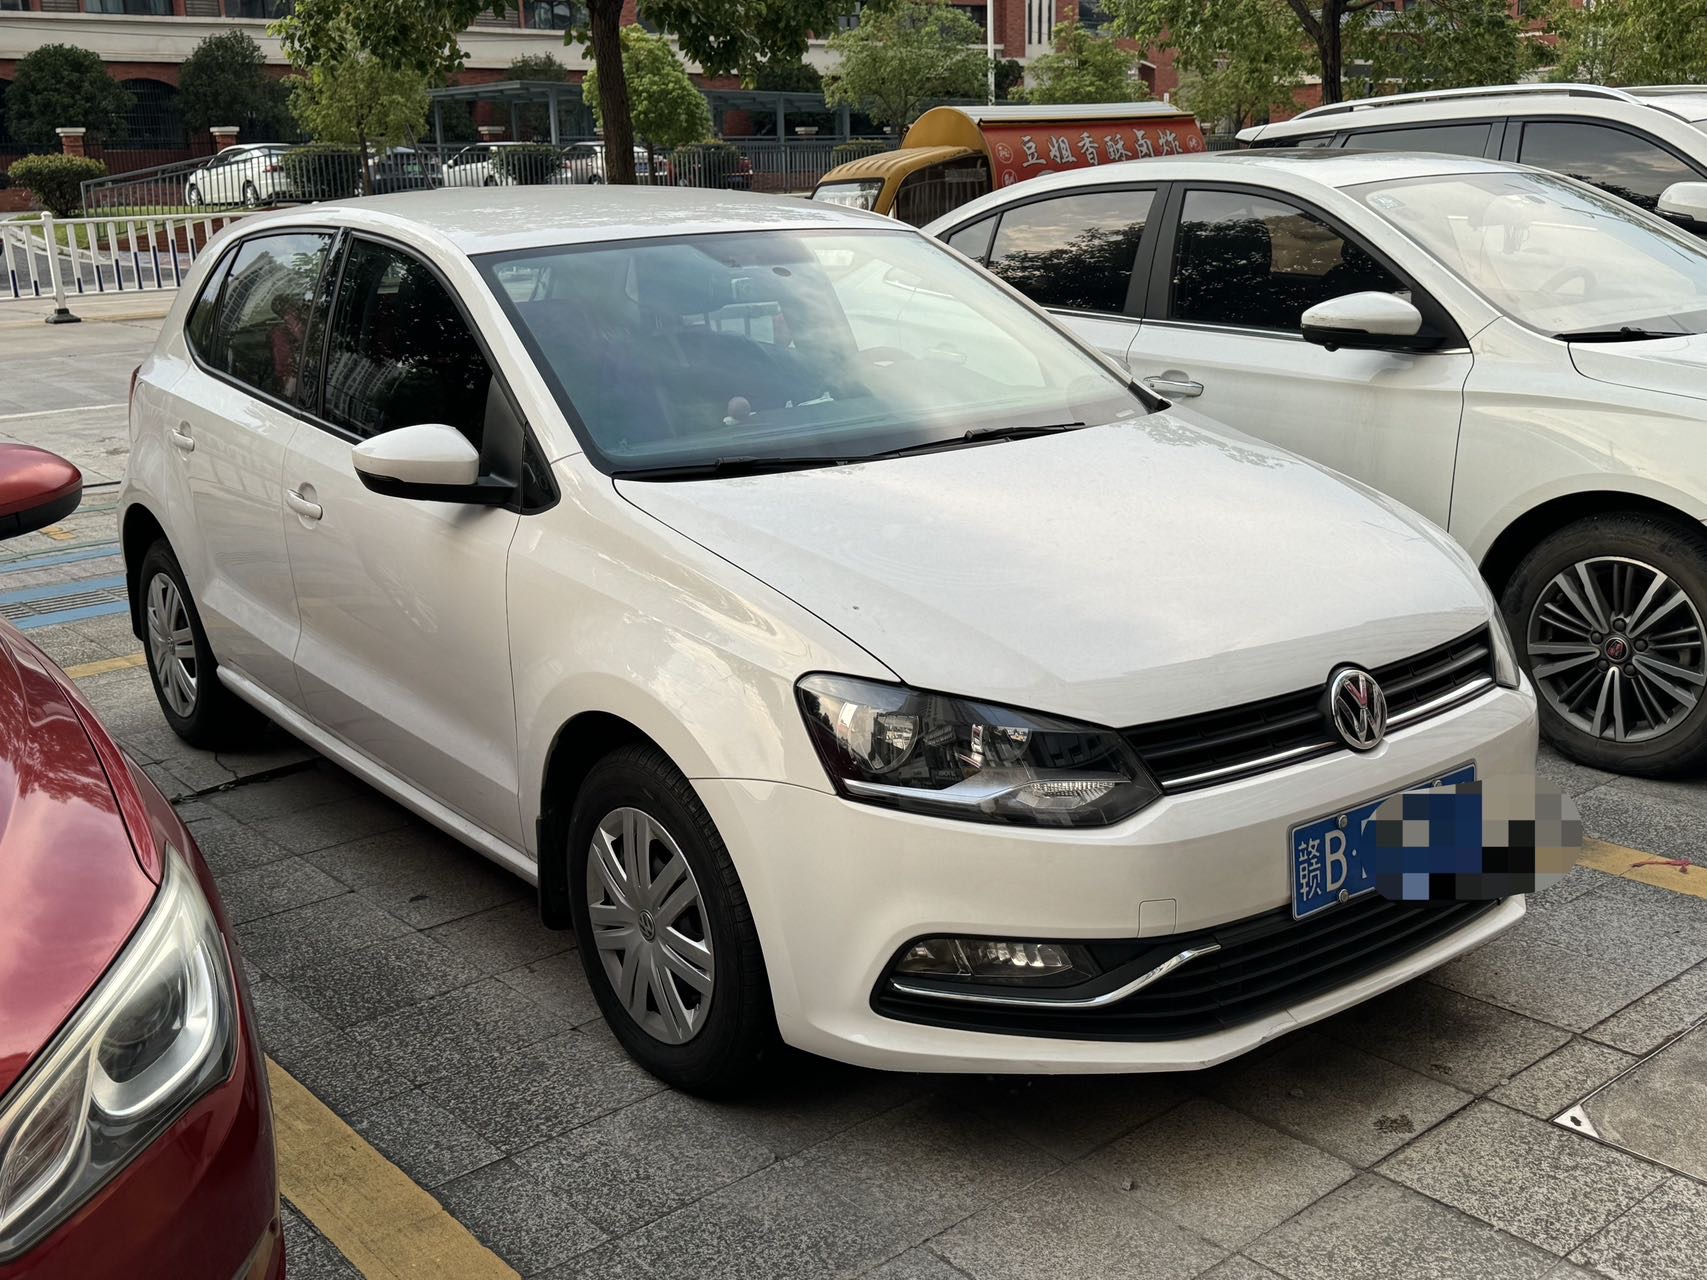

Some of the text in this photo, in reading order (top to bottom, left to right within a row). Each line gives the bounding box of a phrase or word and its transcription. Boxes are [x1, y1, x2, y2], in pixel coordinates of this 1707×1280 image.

[1021, 128, 1183, 167] 豆姐香酥卤炸
